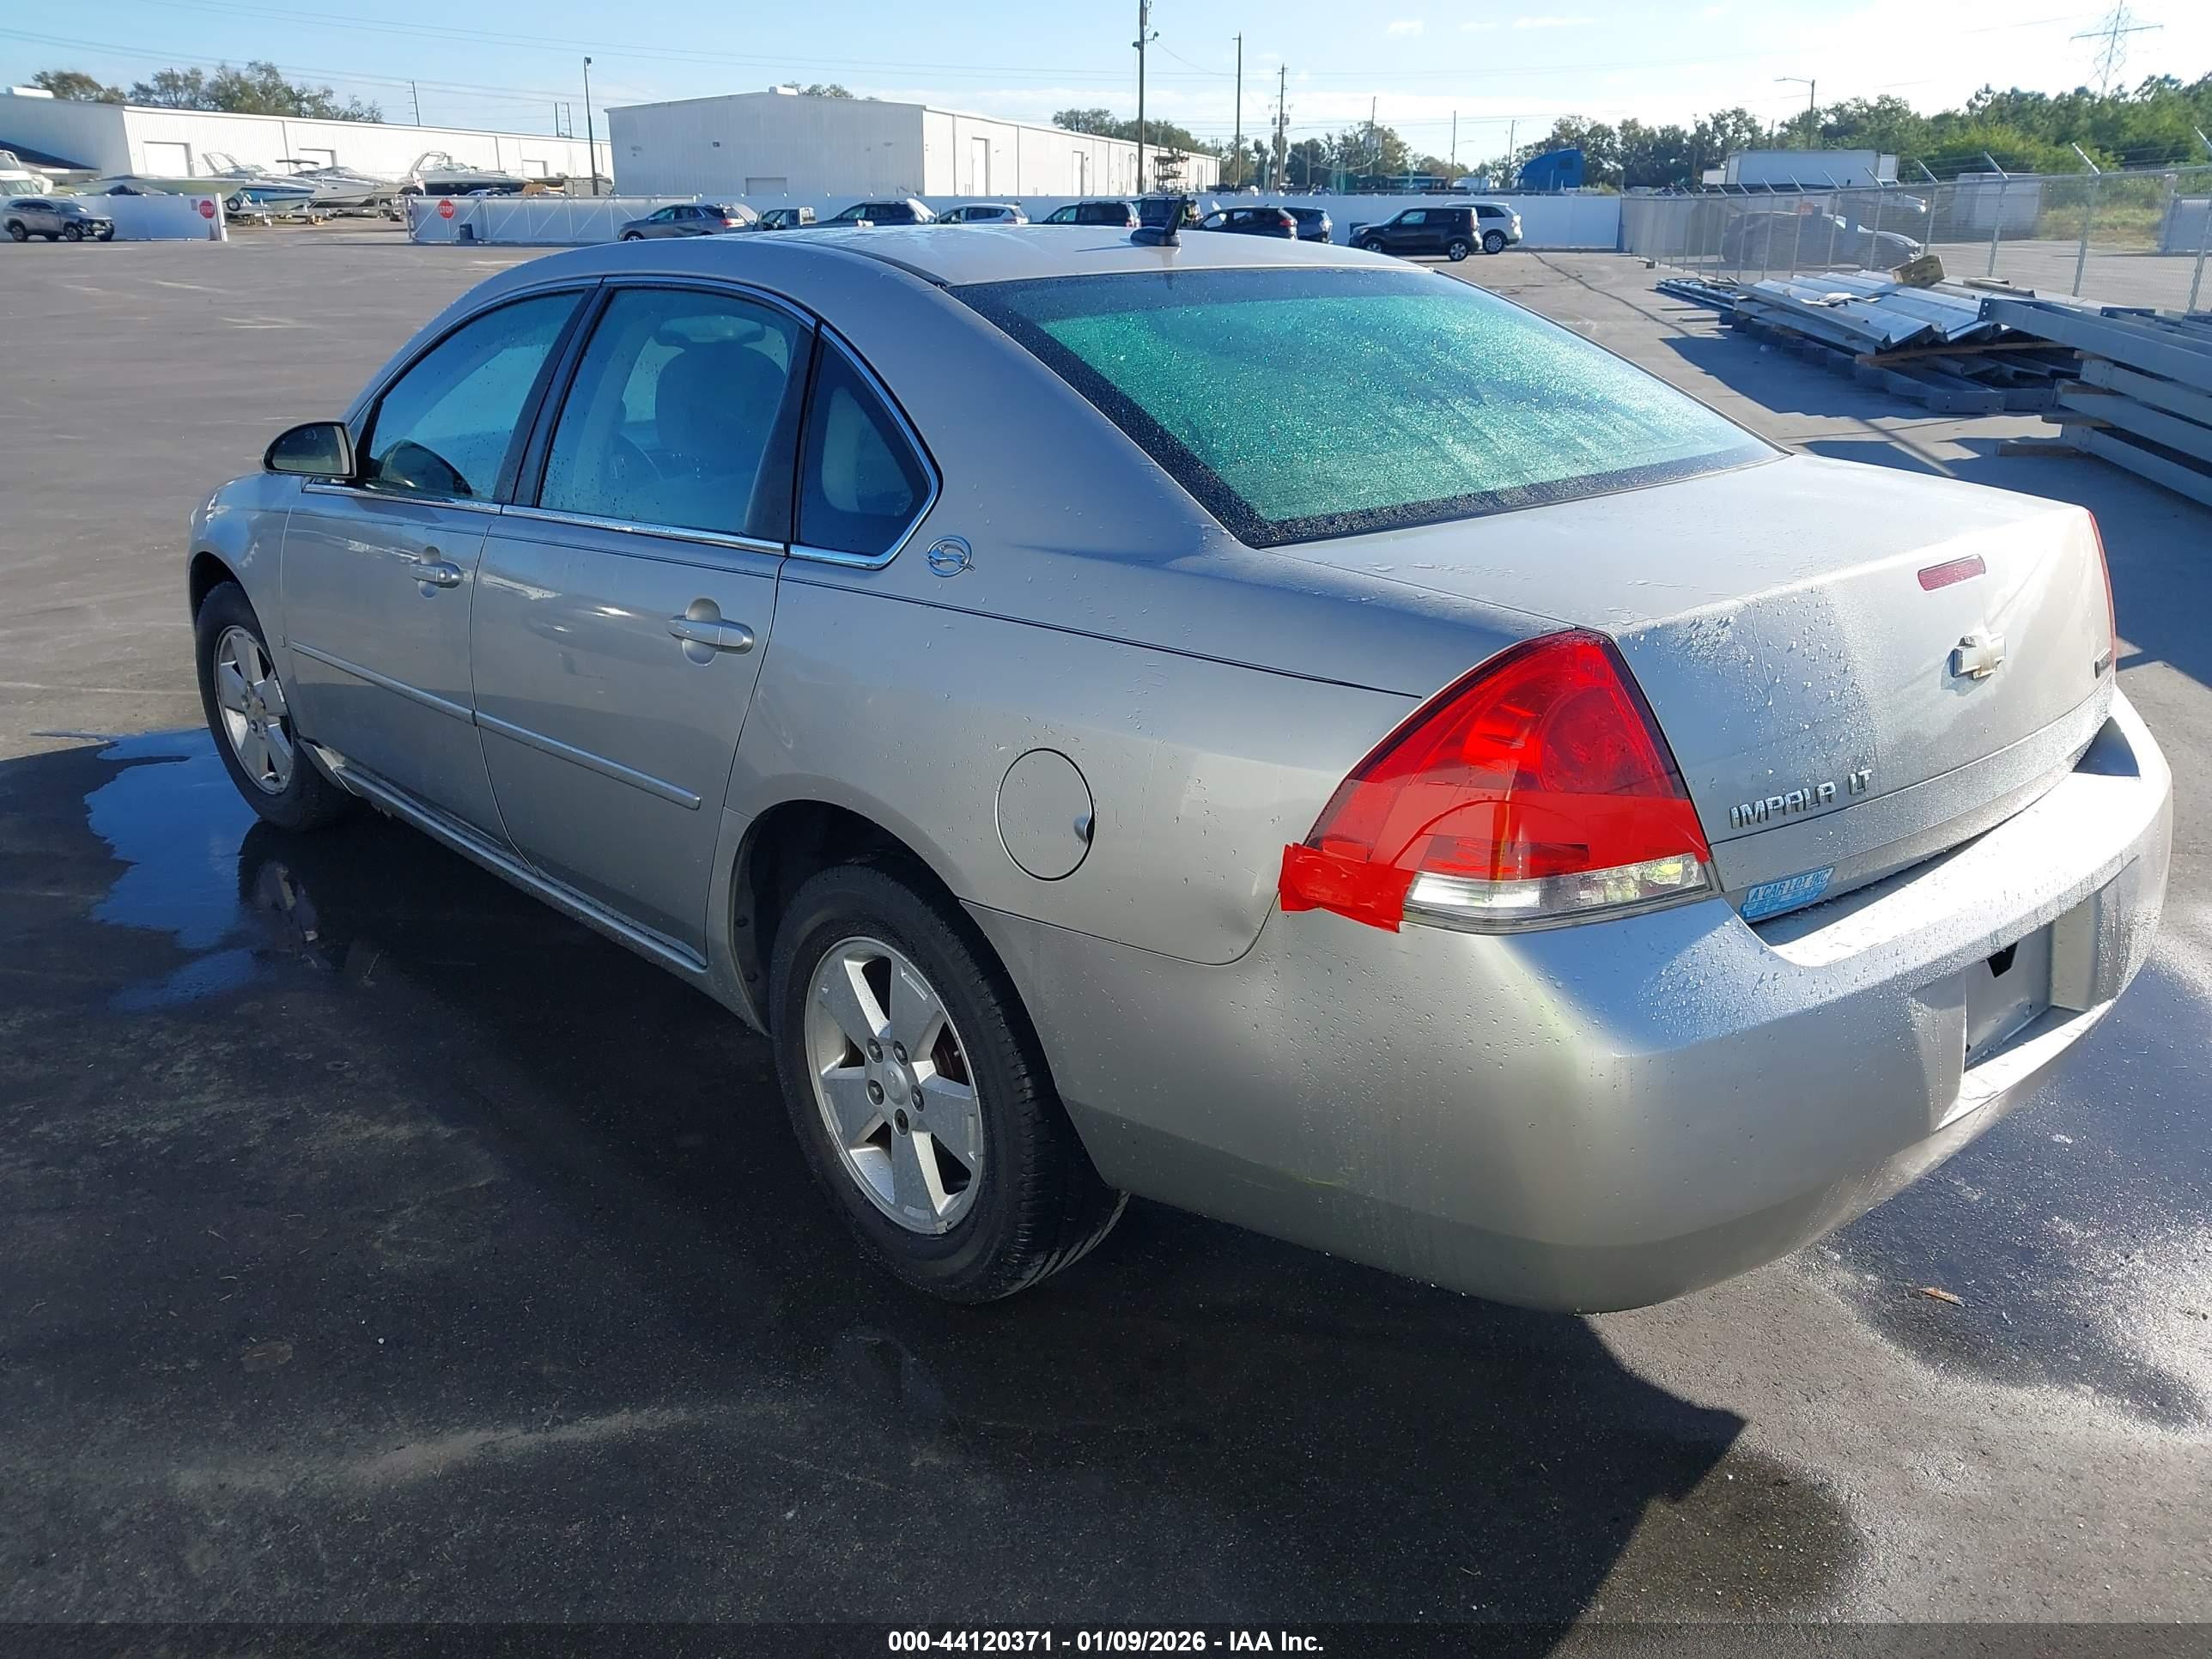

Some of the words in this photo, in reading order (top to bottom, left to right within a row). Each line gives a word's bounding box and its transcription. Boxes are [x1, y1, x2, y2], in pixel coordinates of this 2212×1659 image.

[1729, 781, 1836, 830] IMPALA
[1849, 769, 1873, 795] LT
[1762, 882, 1786, 899] CAR
